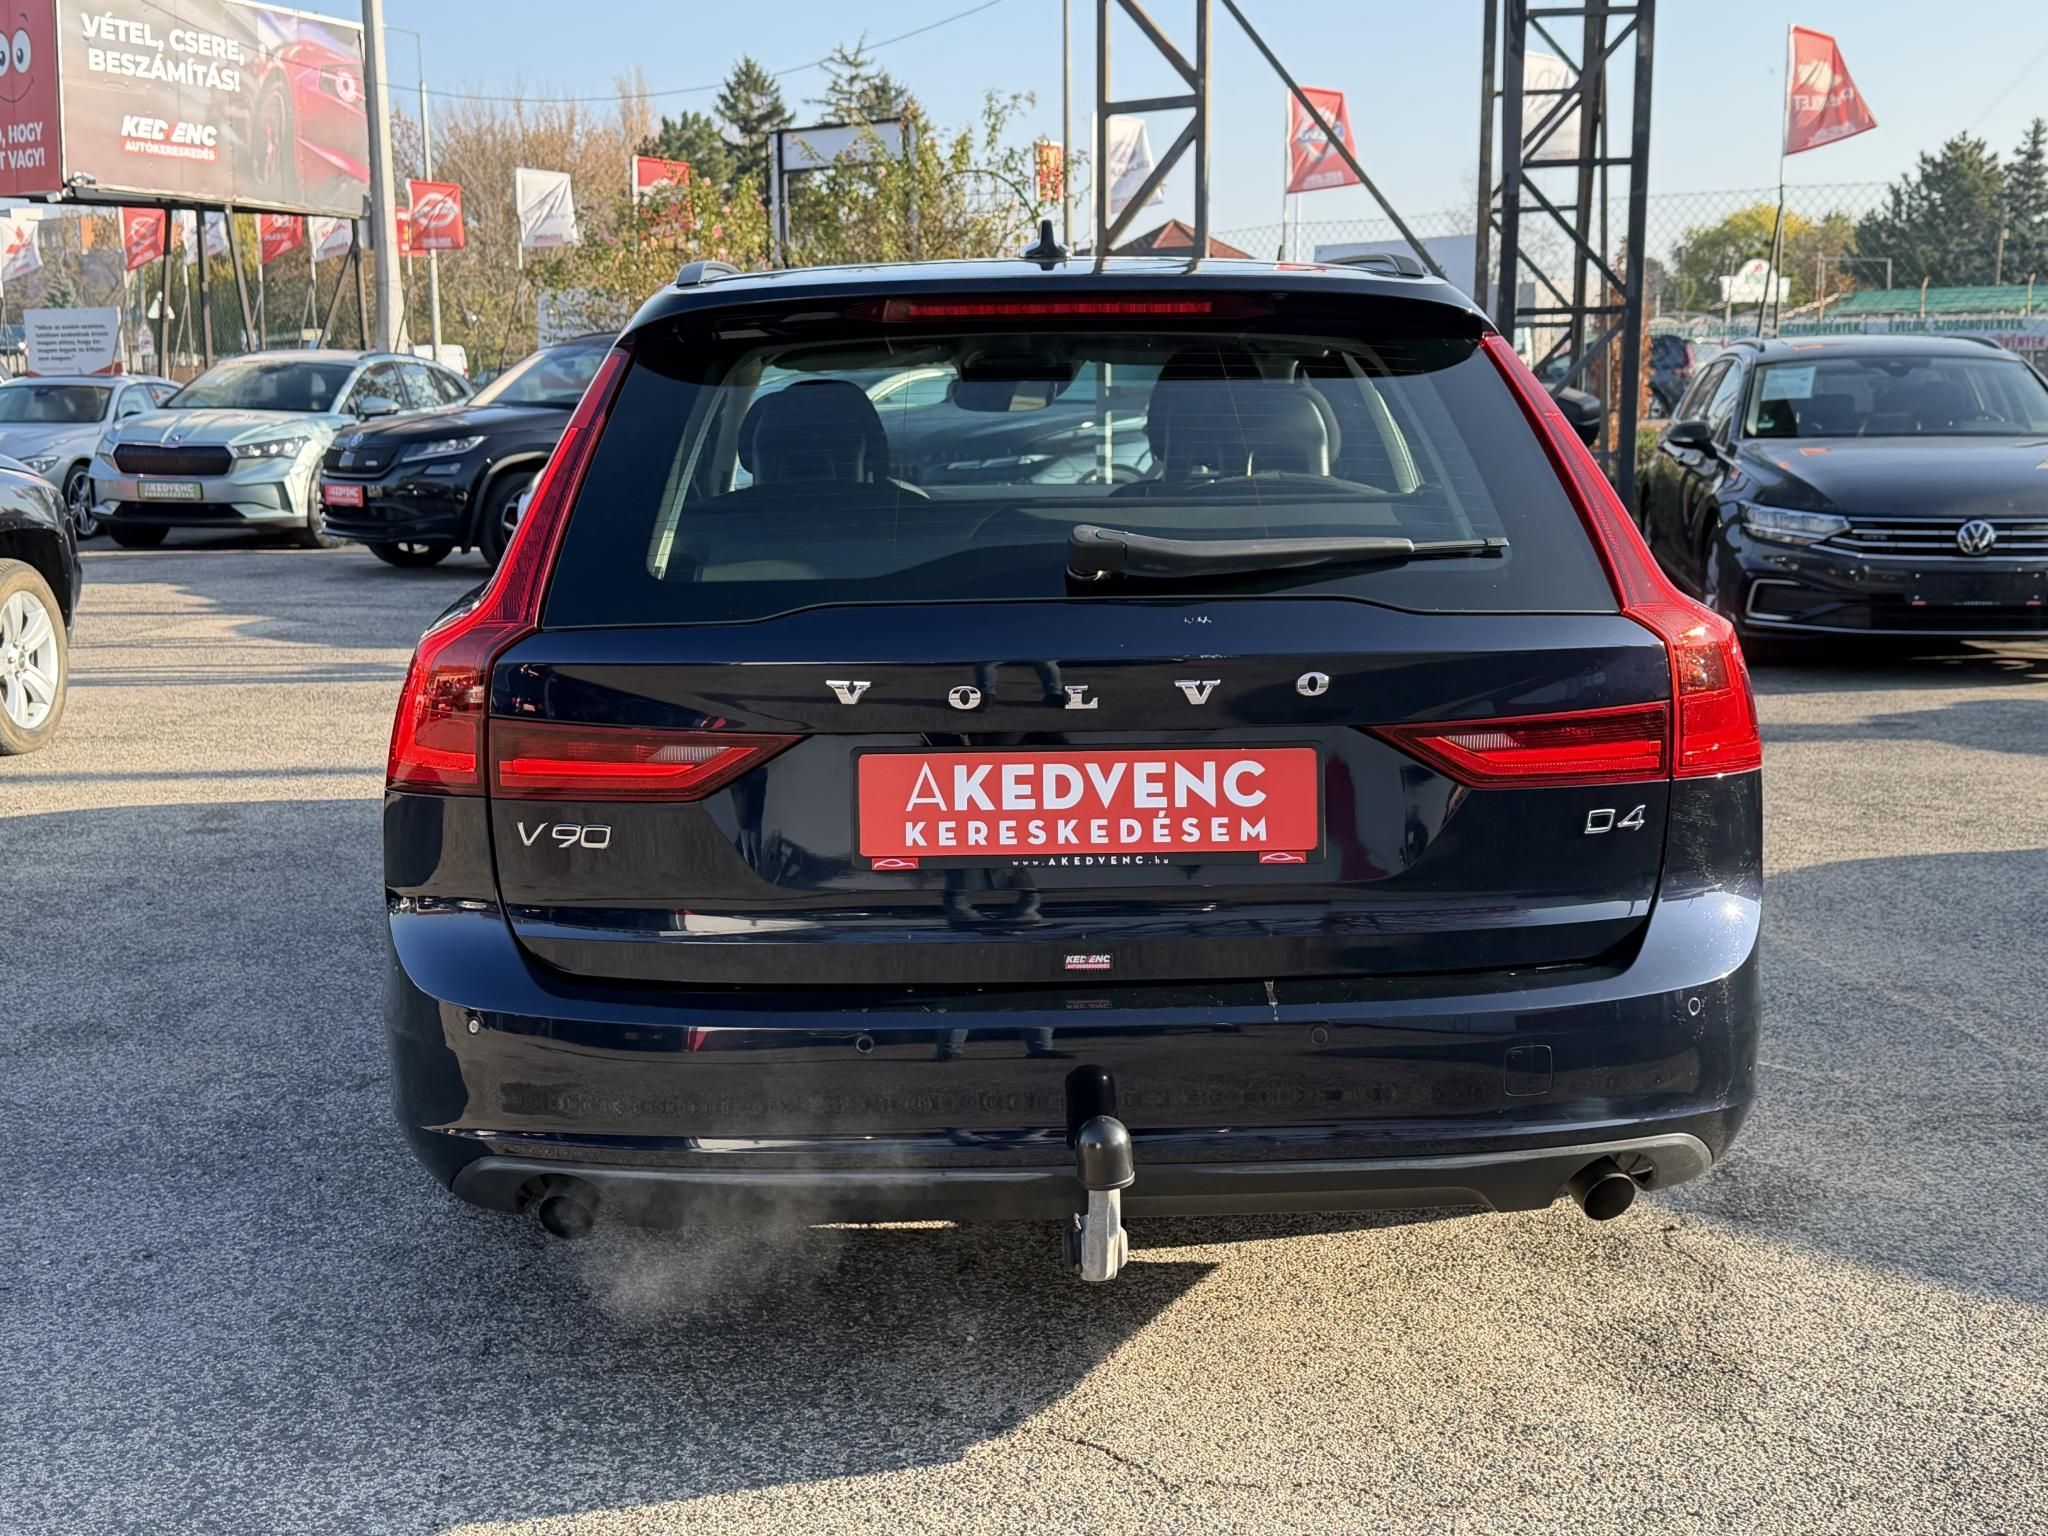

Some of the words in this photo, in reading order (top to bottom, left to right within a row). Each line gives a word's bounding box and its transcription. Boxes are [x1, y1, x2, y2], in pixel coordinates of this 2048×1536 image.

[81, 12, 165, 52] VÉTEL,
[169, 29, 246, 66] CSERE,
[88, 48, 241, 92] BESZÁMÍTÁS!
[8, 121, 43, 144] HOGY
[7, 147, 46, 169] VAGY!
[826, 671, 1330, 711] VOLVO
[905, 760, 1268, 812] AKEDVENC
[905, 811, 1268, 848] KERESKEDÉSEM
[1584, 804, 1646, 834] D4
[1012, 855, 1170, 867] www.AKEDVENC.hu
